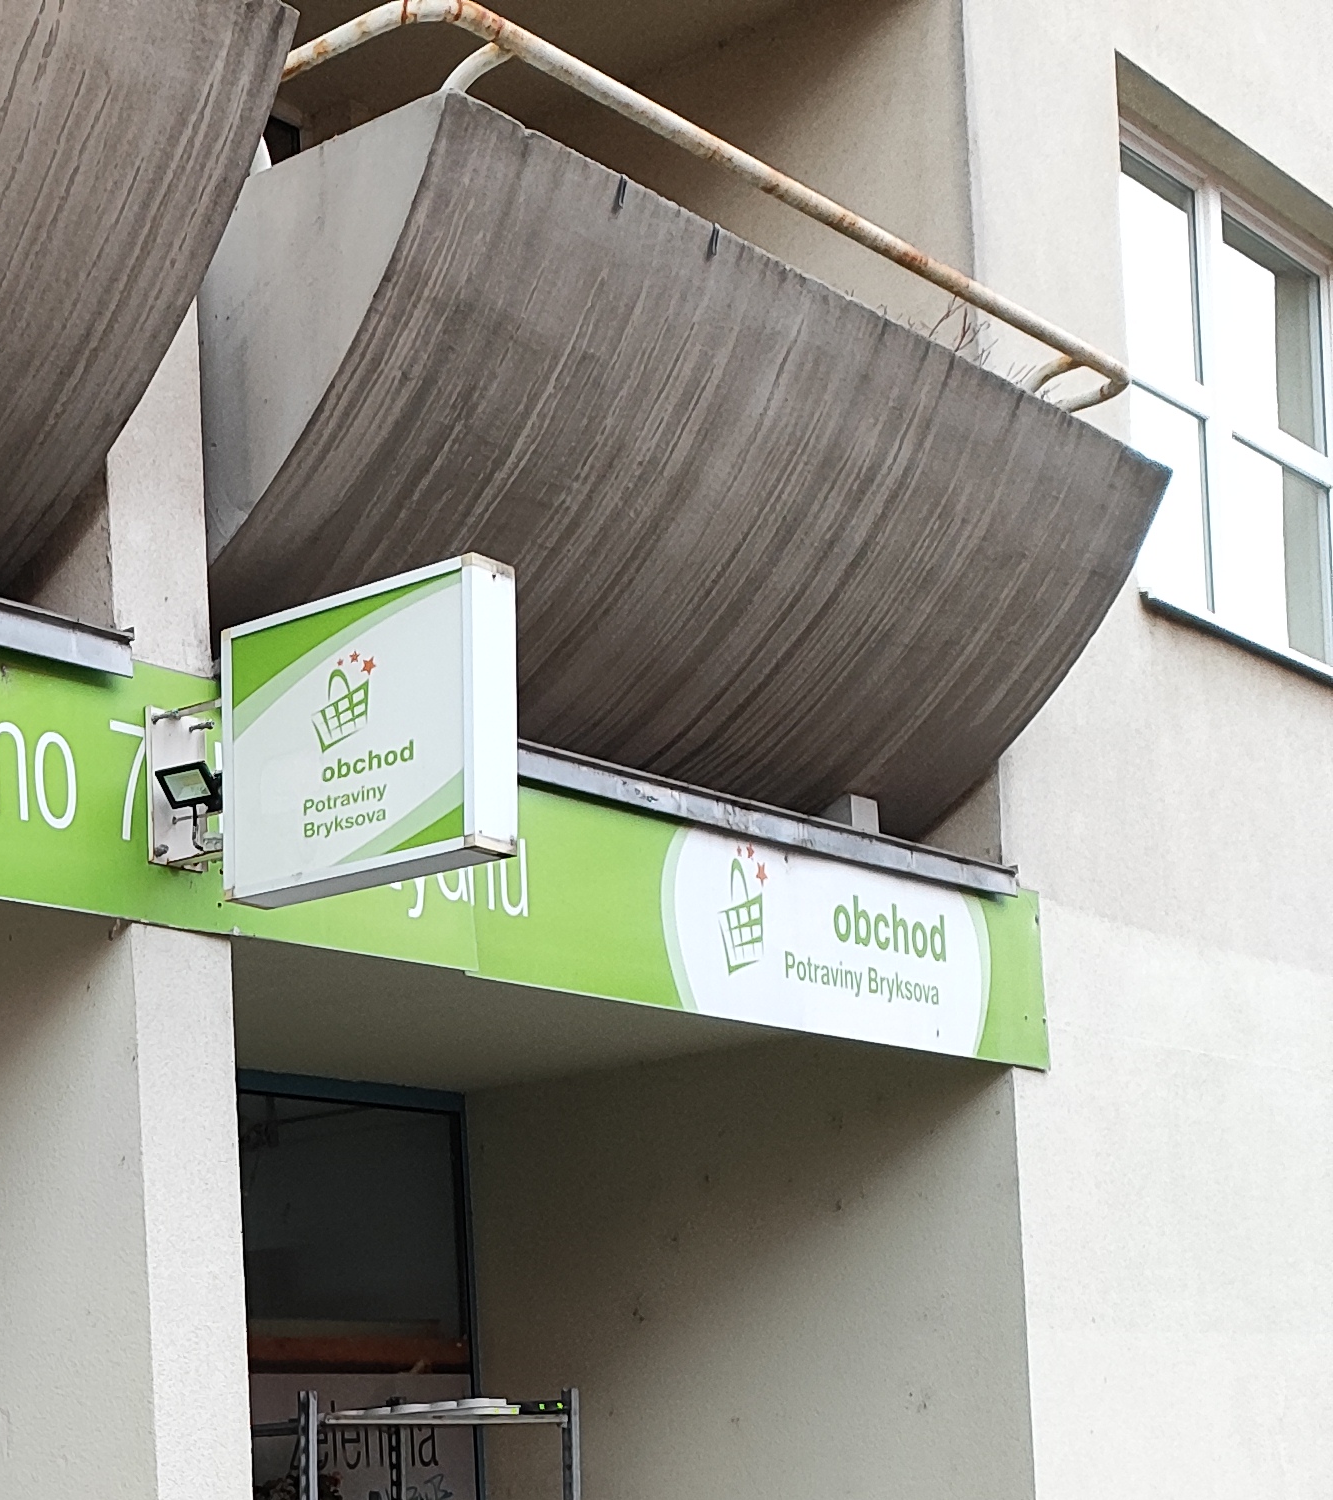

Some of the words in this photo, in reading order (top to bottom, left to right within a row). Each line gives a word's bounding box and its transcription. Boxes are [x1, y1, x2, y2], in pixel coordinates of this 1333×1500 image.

[321, 739, 415, 782] obchod
[302, 781, 388, 816] Potraviny
[302, 805, 387, 838] Bryksova
[833, 894, 947, 962] obchod
[784, 951, 863, 997] Potraviny
[867, 966, 940, 1006] Bryksova
